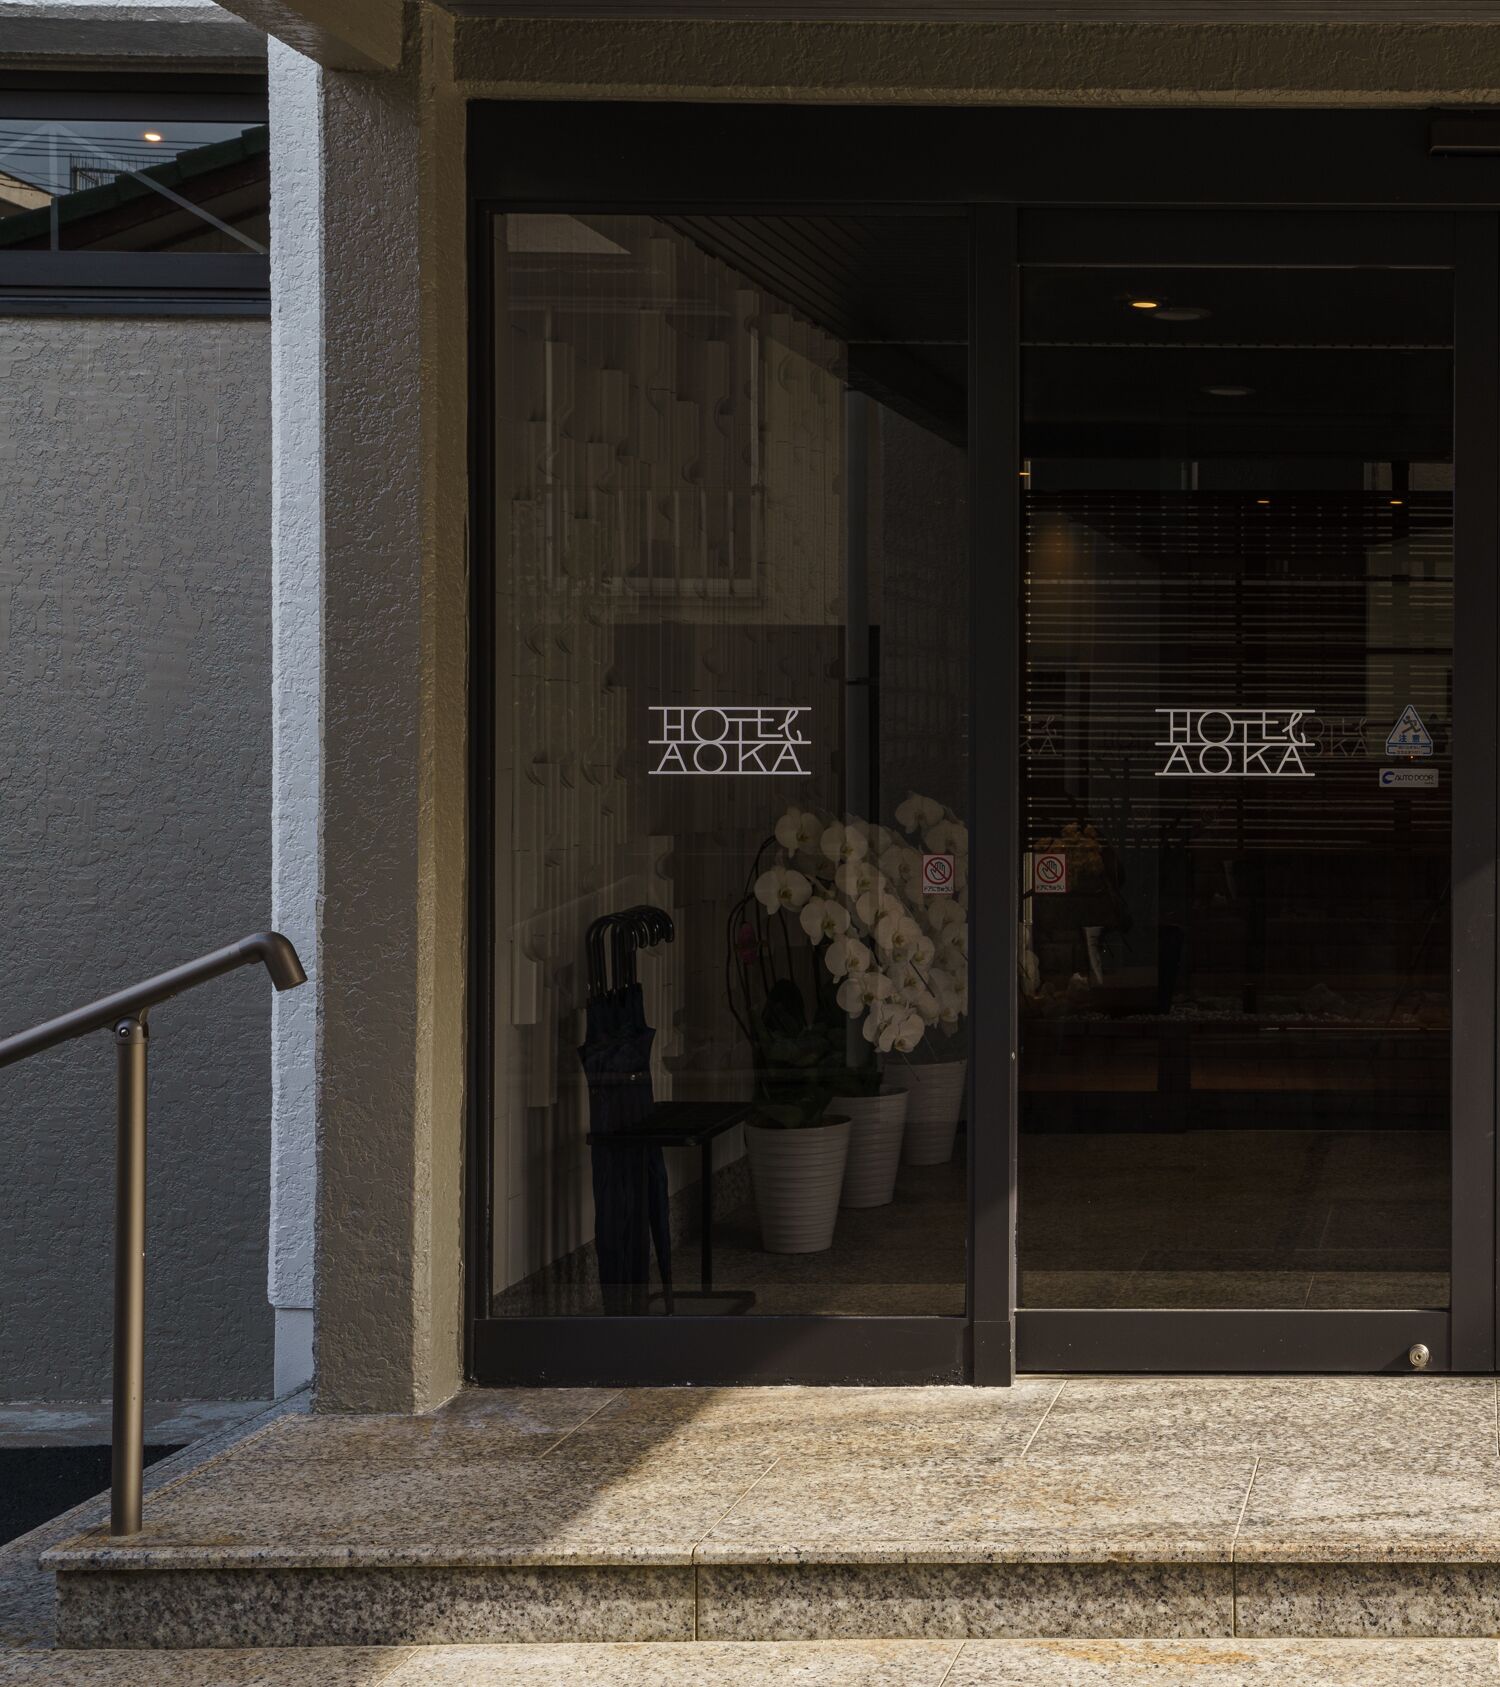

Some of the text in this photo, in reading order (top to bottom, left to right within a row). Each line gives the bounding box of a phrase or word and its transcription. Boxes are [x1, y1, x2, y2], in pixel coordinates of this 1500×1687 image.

[1398, 734, 1421, 743] 注意
[657, 743, 801, 776] AOKA
[1162, 745, 1306, 776] AOKA
